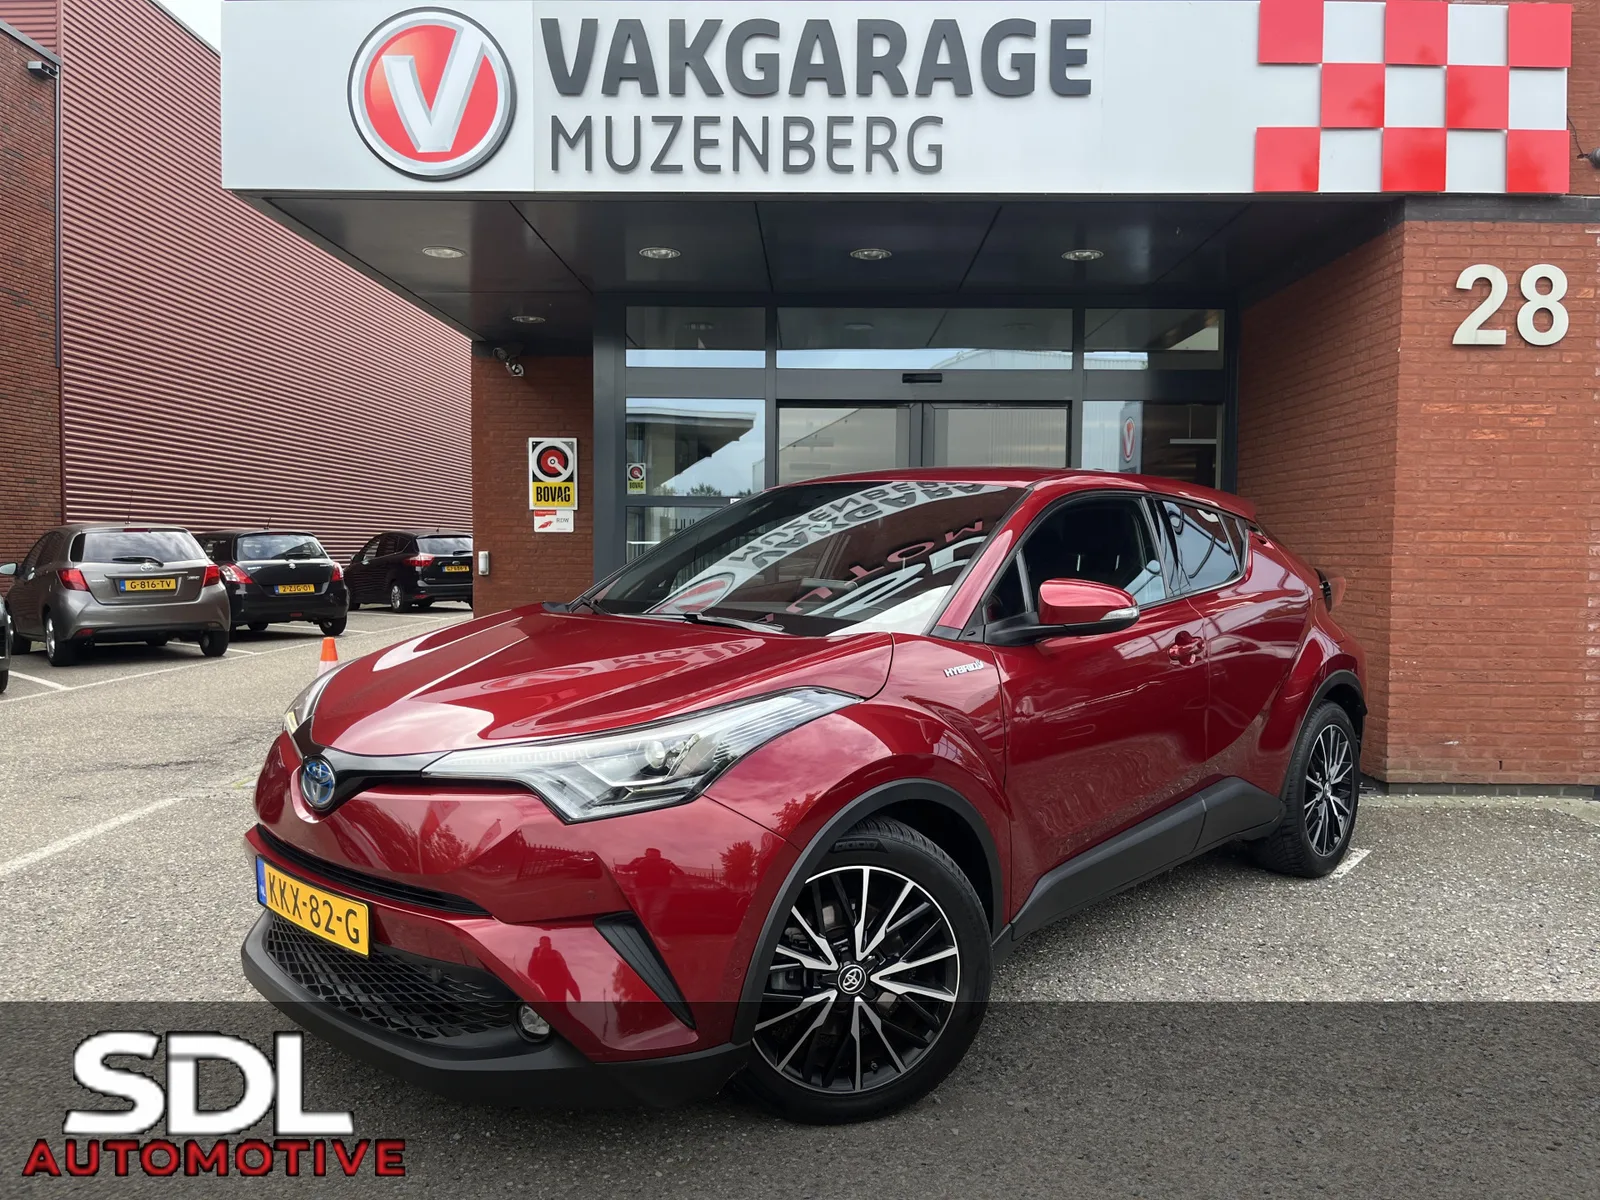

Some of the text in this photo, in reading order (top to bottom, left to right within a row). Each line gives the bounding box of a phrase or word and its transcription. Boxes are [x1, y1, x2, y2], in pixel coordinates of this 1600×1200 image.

[540, 18, 1092, 97] VAKGARAGE
[551, 115, 944, 175] MUZENBERG
[1452, 264, 1569, 346] 28
[535, 485, 571, 503] BOVAG
[629, 481, 644, 489] BOVAG
[130, 580, 172, 590] G-816-TV
[943, 661, 977, 678] HYBRID
[268, 871, 361, 945] KKX-82-G
